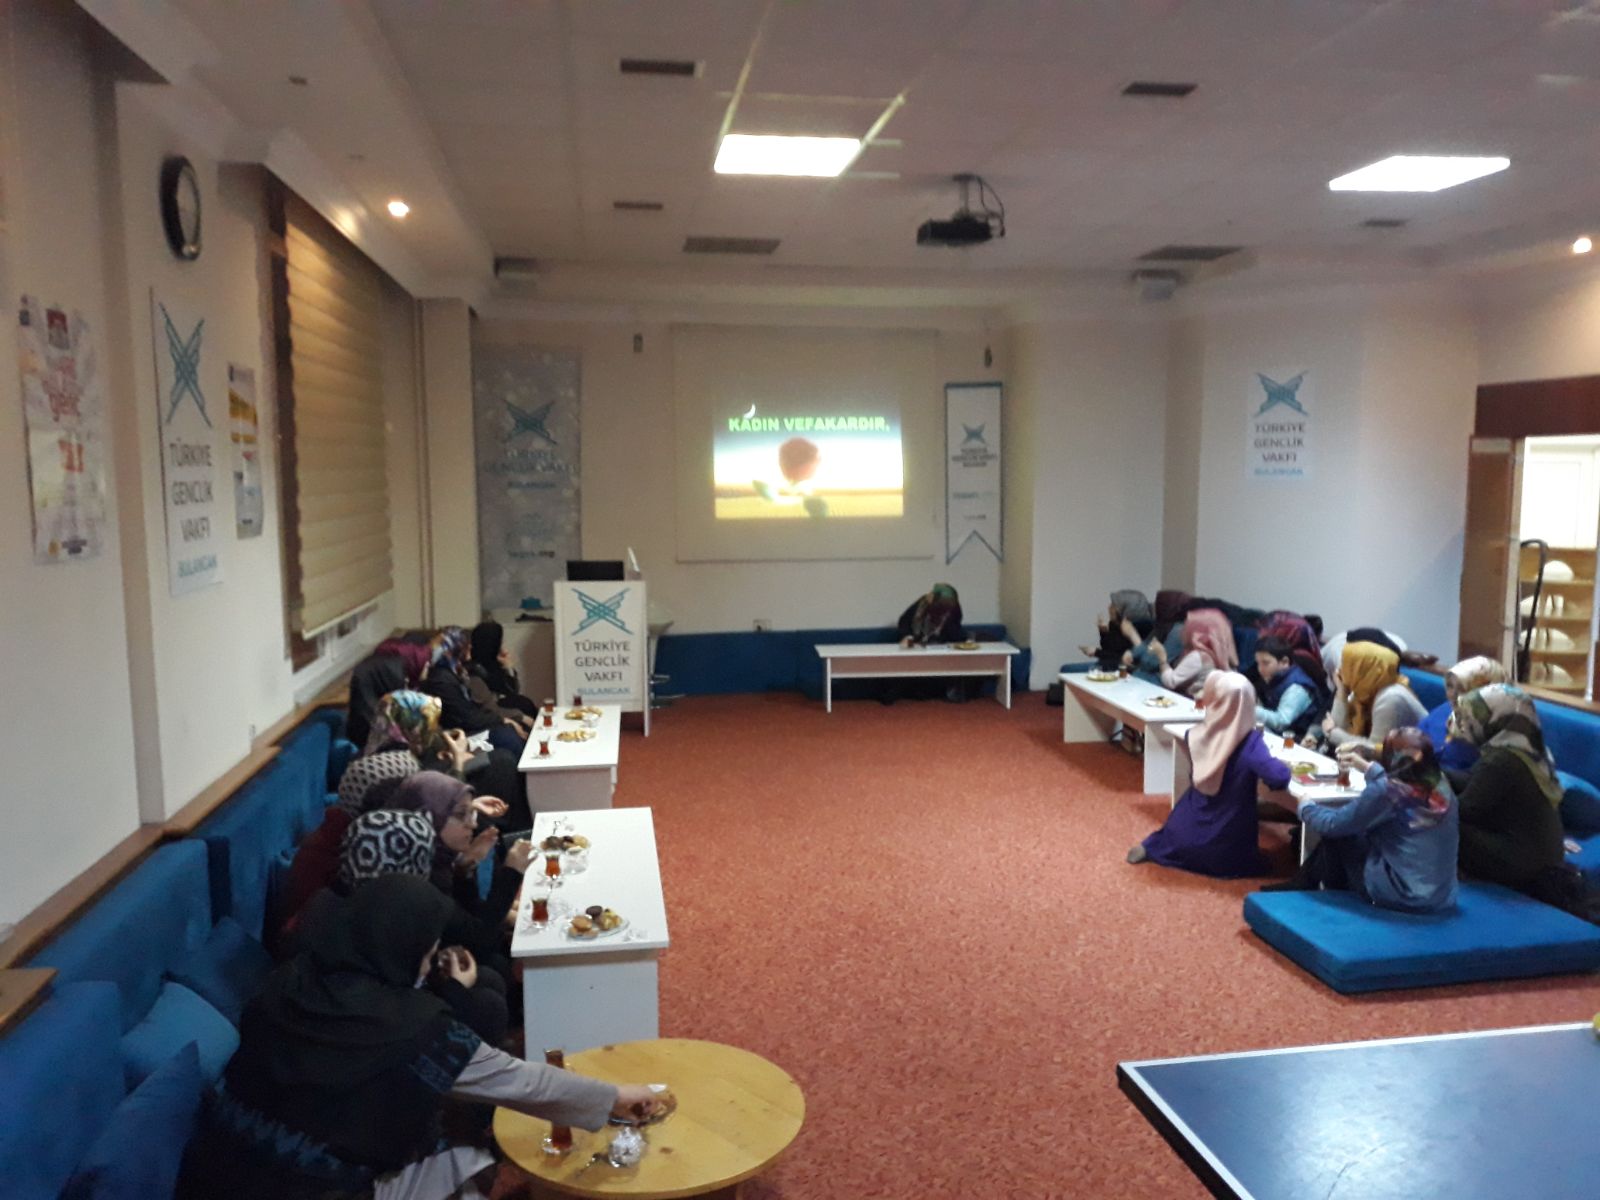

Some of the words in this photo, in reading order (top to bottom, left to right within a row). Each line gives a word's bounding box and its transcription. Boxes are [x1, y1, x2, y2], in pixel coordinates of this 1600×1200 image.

[728, 417, 779, 432] KADIN
[1262, 451, 1297, 462] VAKFI
[574, 639, 631, 652] TÜRKİYE
[584, 671, 623, 682] VAKFI
